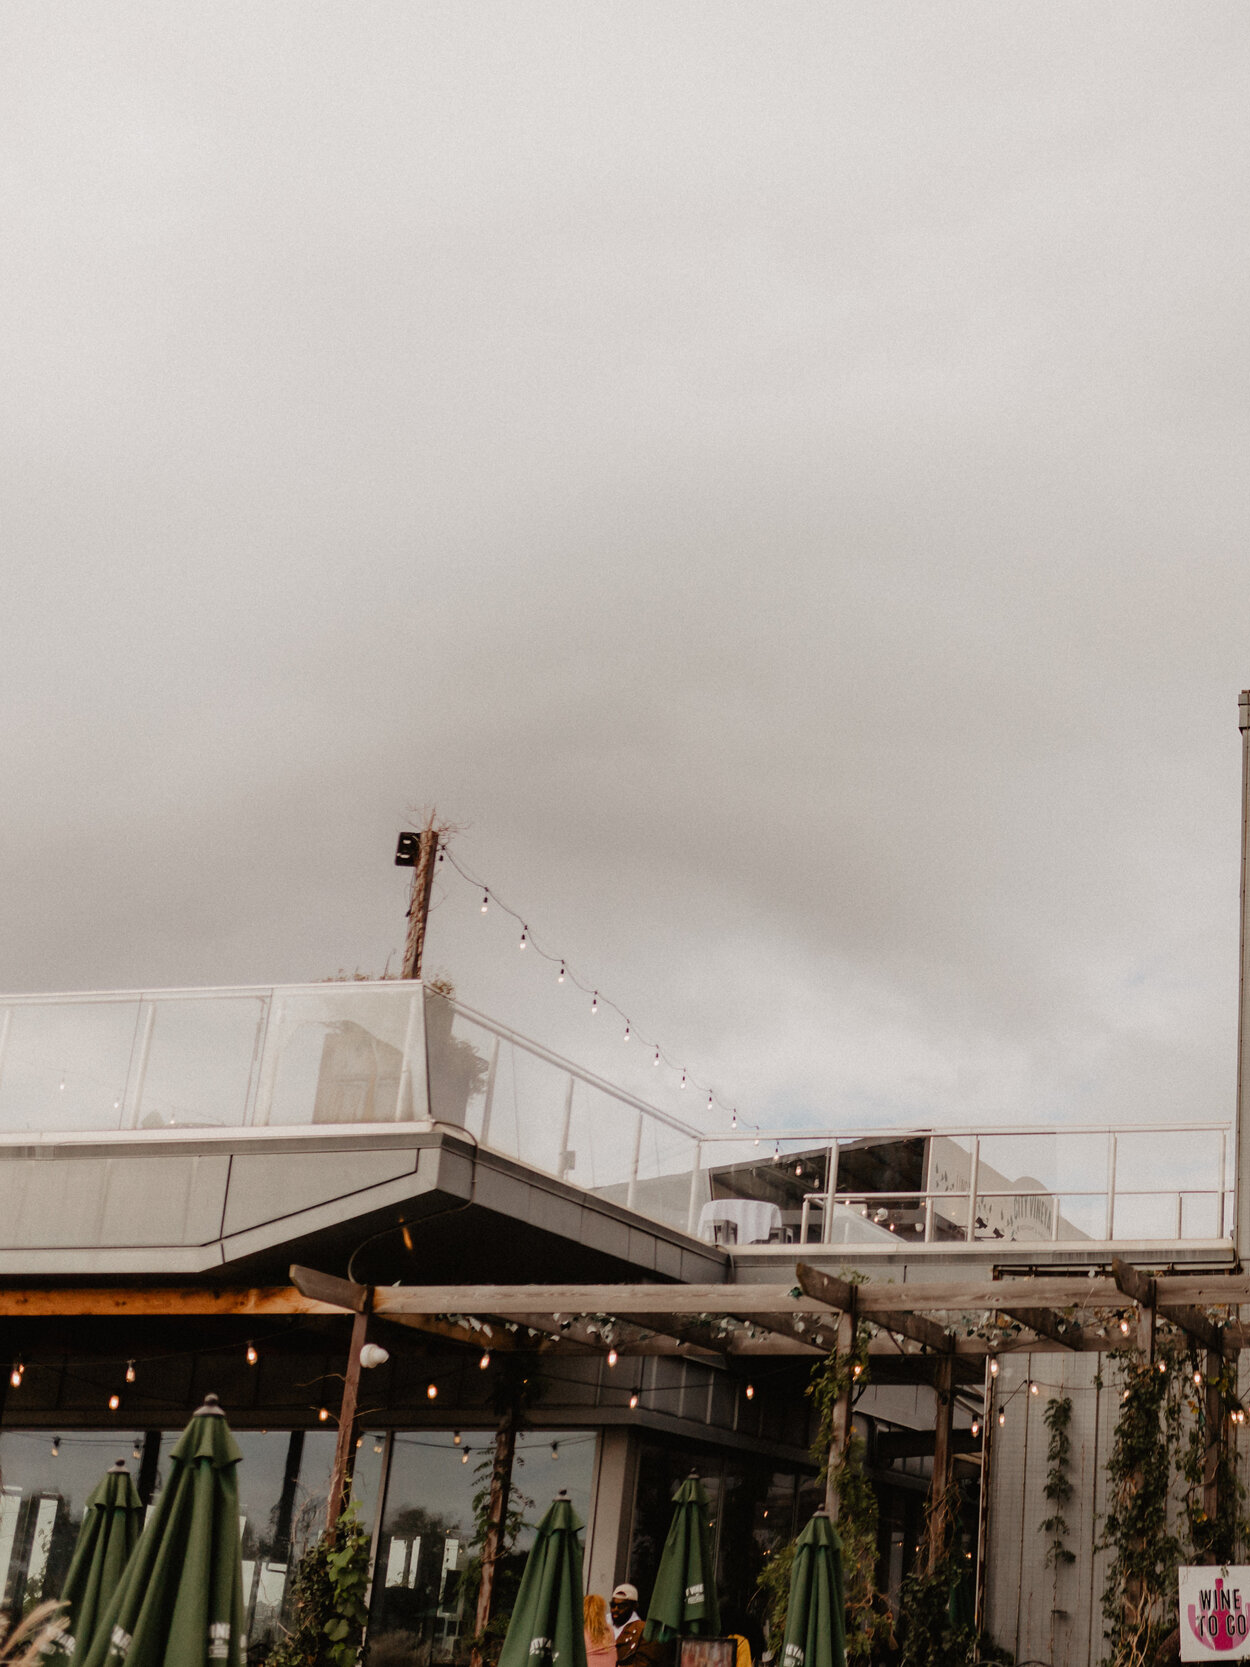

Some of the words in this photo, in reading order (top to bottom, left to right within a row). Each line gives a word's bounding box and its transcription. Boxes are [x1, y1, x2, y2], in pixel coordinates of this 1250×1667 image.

[1199, 1589, 1241, 1611] WINE
[1198, 1615, 1218, 1636] TO
[1227, 1614, 1247, 1636] GO
